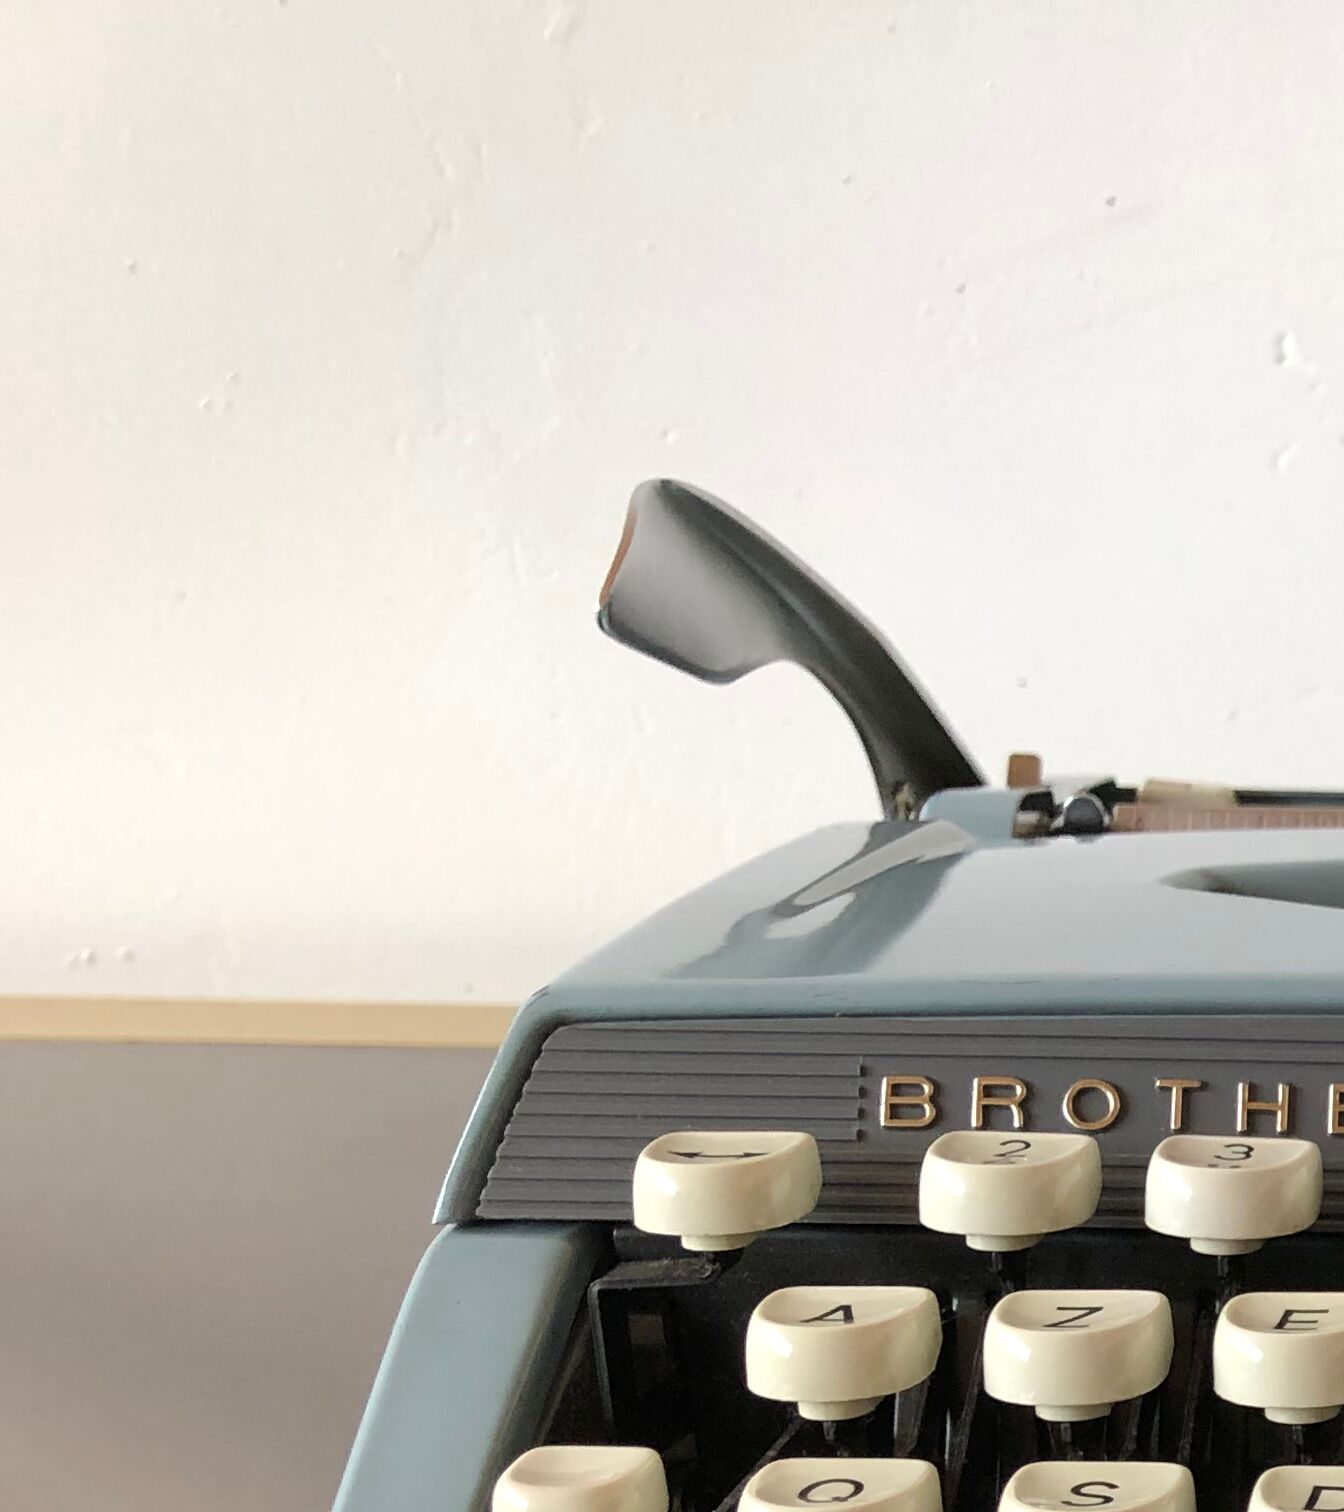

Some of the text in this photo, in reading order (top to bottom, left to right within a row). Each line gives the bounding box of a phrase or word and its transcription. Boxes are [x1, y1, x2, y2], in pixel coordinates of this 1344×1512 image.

[994, 1139, 1032, 1158] 2
[1214, 1143, 1255, 1161] 3
[799, 1304, 854, 1324] A
[1042, 1306, 1104, 1329] Z
[1272, 1309, 1329, 1331] E
[797, 1478, 865, 1503] Q
[1068, 1480, 1120, 1508] S
